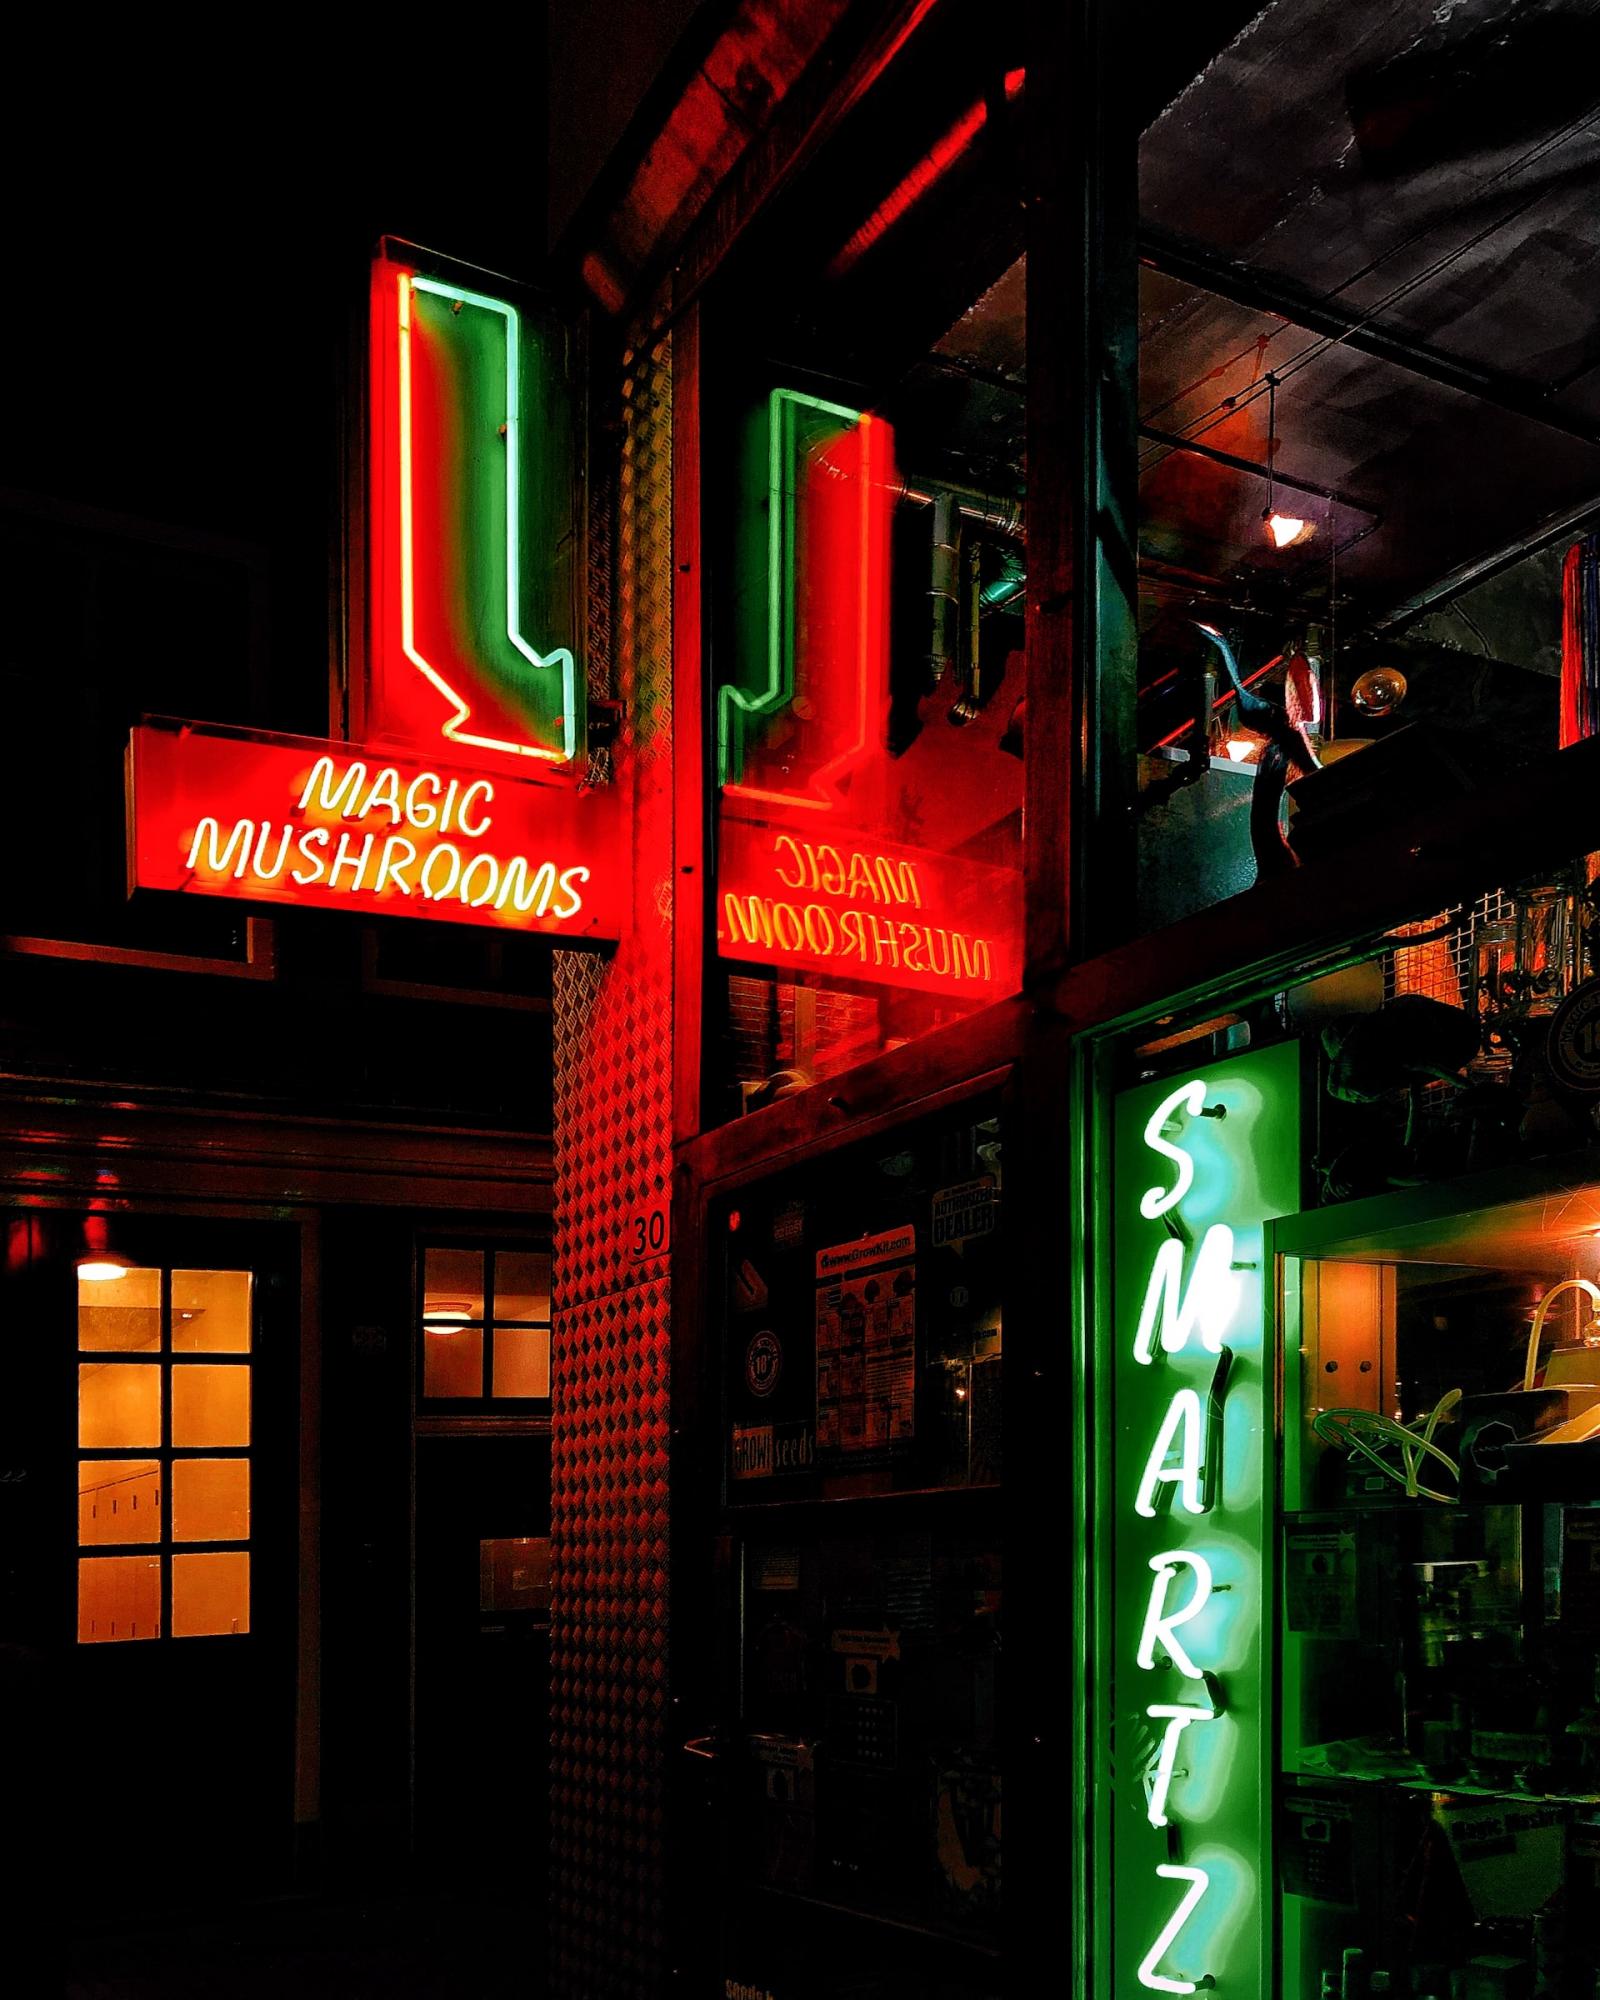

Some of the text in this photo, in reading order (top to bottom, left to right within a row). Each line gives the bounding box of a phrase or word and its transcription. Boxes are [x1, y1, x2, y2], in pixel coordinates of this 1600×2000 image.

[298, 757, 494, 838] MAGIC
[186, 817, 591, 920] MUSHROOMS
[633, 1210, 665, 1256] 30
[776, 1427, 815, 1468] seeds
[1135, 1077, 1236, 1995] SMARTZ
